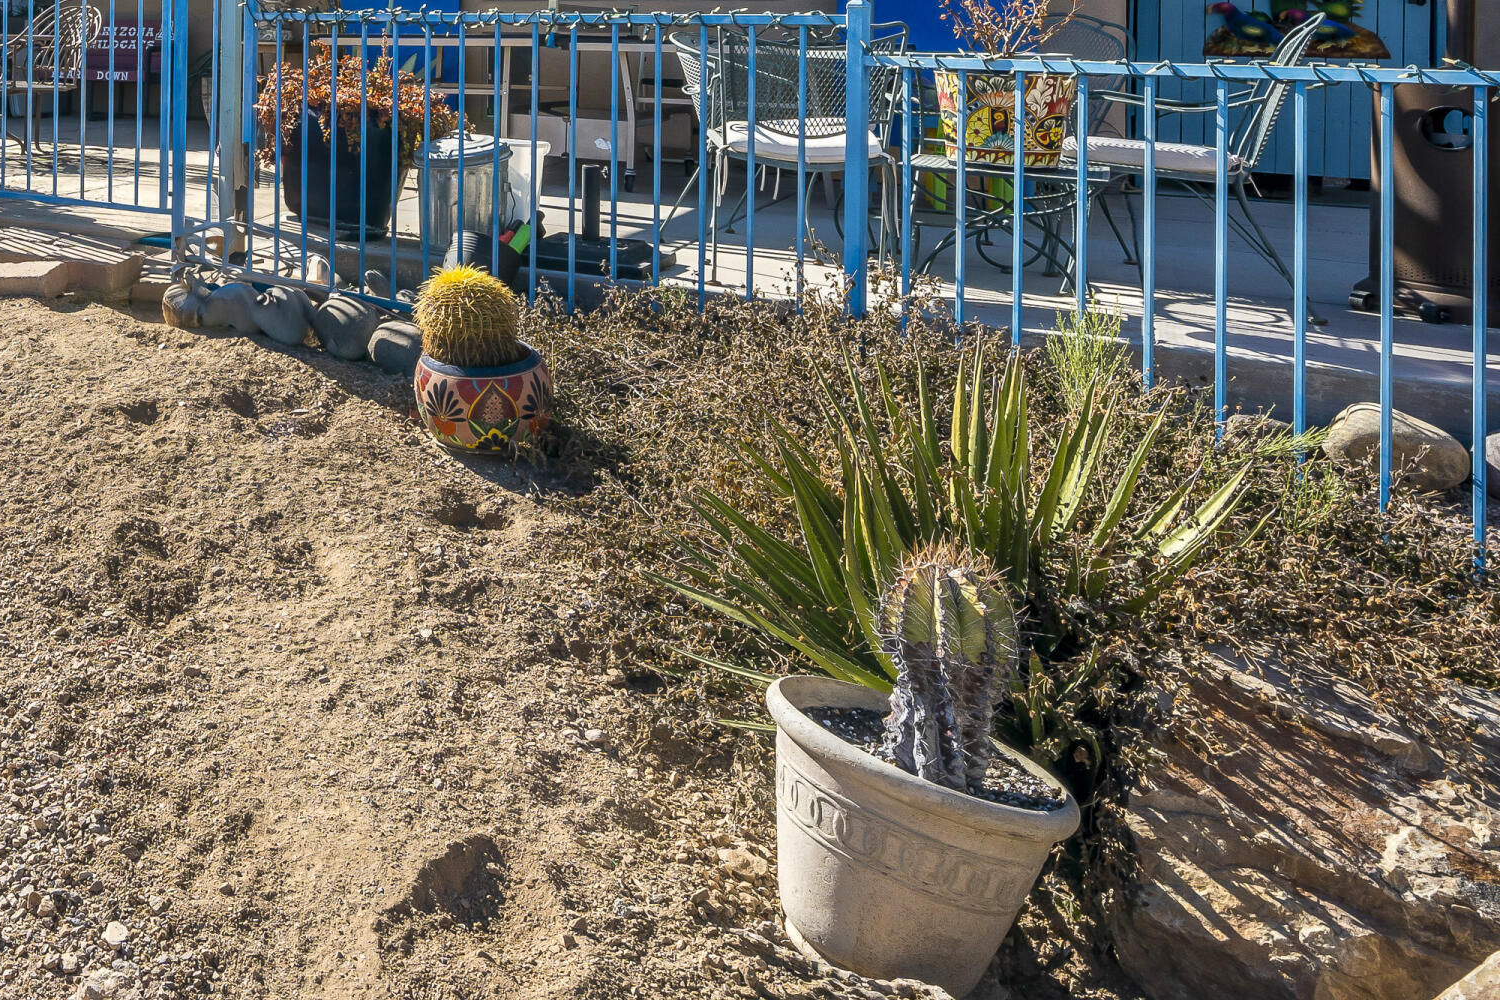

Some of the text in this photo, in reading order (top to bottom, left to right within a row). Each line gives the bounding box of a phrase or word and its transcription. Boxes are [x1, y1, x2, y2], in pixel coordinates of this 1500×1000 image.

[90, 26, 155, 37] RIZOA
[90, 39, 155, 50] ILDCAS
[96, 70, 129, 81] DOWN
